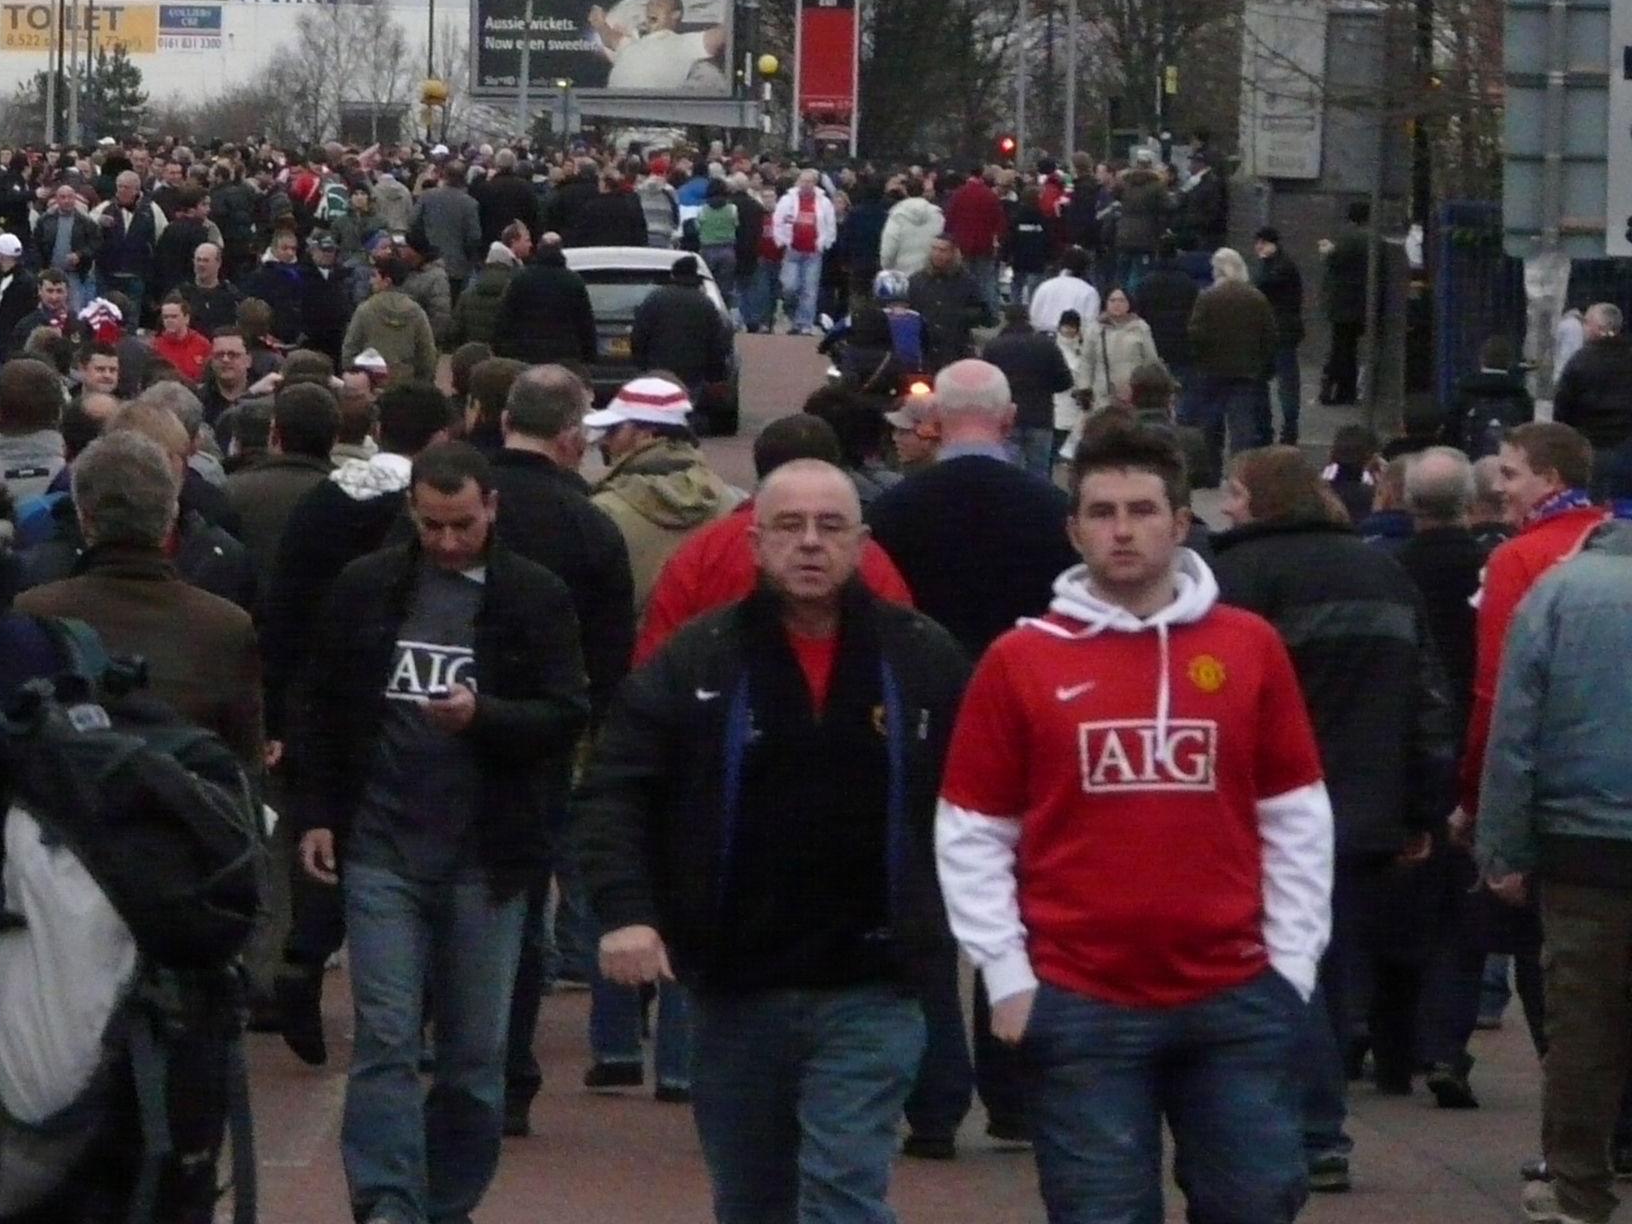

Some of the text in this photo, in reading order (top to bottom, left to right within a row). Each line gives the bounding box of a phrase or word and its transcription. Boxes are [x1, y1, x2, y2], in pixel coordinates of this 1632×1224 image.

[3, 4, 51, 30] TO
[485, 16, 526, 30] Aussie
[485, 36, 514, 49] Now
[516, 39, 545, 50] een
[388, 648, 478, 694] AIG
[1090, 727, 1210, 782] AIG
